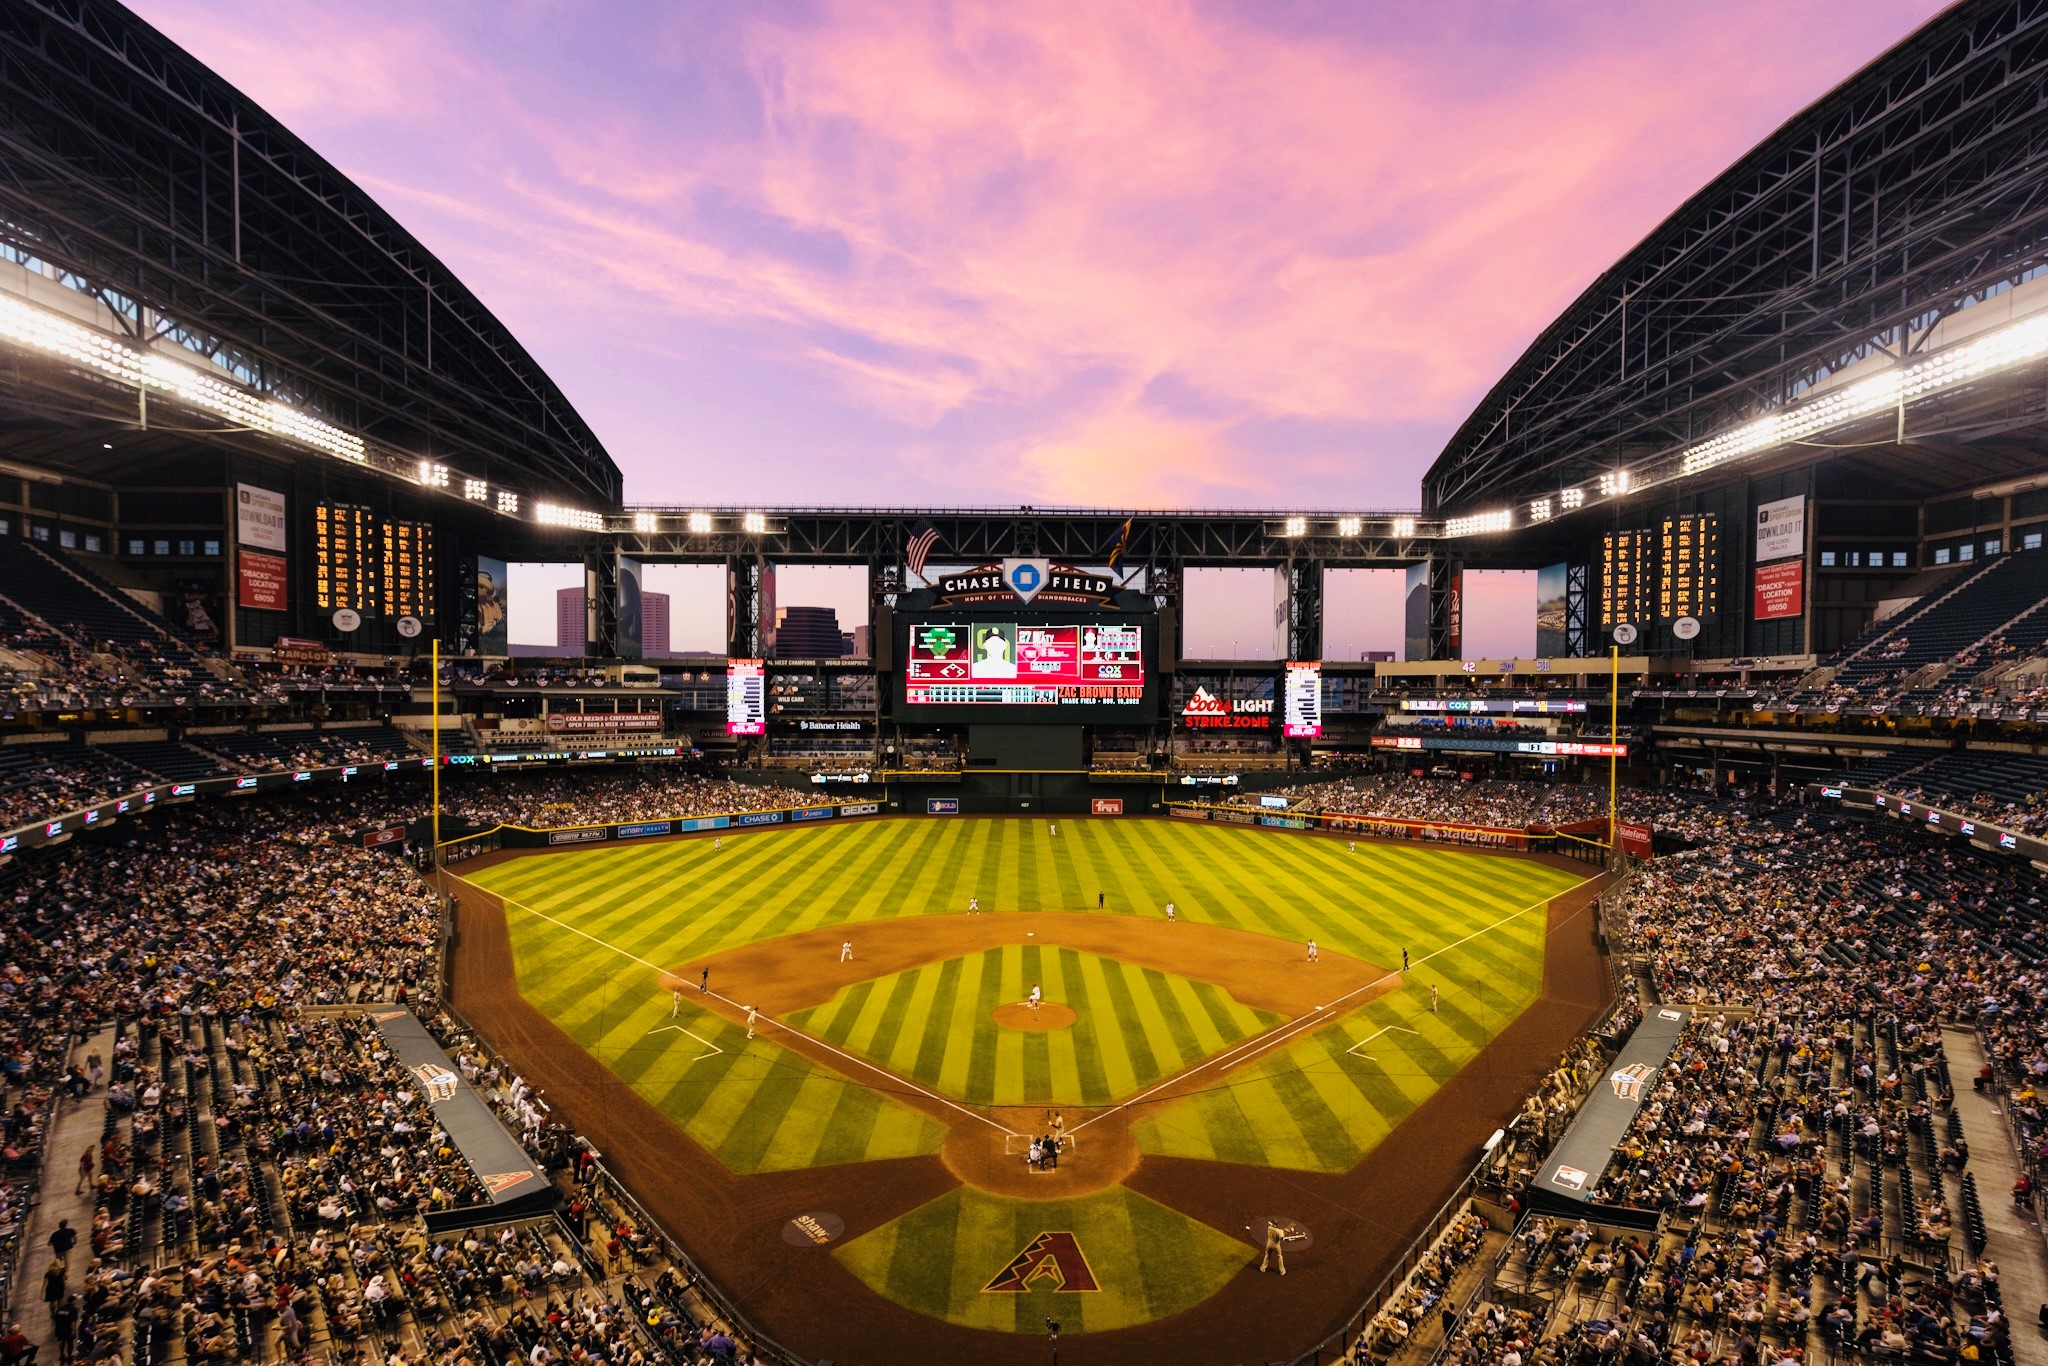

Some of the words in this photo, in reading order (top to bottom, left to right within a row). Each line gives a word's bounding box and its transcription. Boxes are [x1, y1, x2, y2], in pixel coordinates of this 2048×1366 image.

[240, 508, 276, 527] DOWNLOAD
[277, 517, 284, 529] IT
[1758, 522, 1792, 540] DOWNLOAD
[1795, 520, 1802, 532] IT
[1769, 544, 1787, 552] DBACKS
[249, 579, 279, 589] LOCATION
[945, 576, 1000, 592] CHASE
[1053, 577, 1107, 592] FIELD
[254, 593, 275, 603] 69050
[1763, 588, 1792, 599] LOCATION
[1037, 595, 1087, 603] DIAMONDBACKS
[1768, 603, 1787, 612] 69050
[1098, 665, 1122, 675] COX
[1462, 662, 1476, 672] 42
[1500, 662, 1514, 672] 20
[1536, 660, 1550, 672] 51
[1059, 687, 1077, 698] ZAC
[1080, 687, 1114, 698] BROWN
[1117, 687, 1143, 699] BAND
[1186, 694, 1232, 711] Coors
[1233, 699, 1274, 712] LIGHT
[809, 722, 836, 730] Banner
[837, 721, 860, 730] Health
[1186, 716, 1230, 727] STRIKE
[1233, 716, 1269, 727] ZONE
[1454, 717, 1493, 727] ULTRA
[842, 804, 878, 815] GEICO
[1095, 801, 1119, 813] fry's
[744, 814, 770, 823] CHASE
[798, 1215, 827, 1237] shaw
